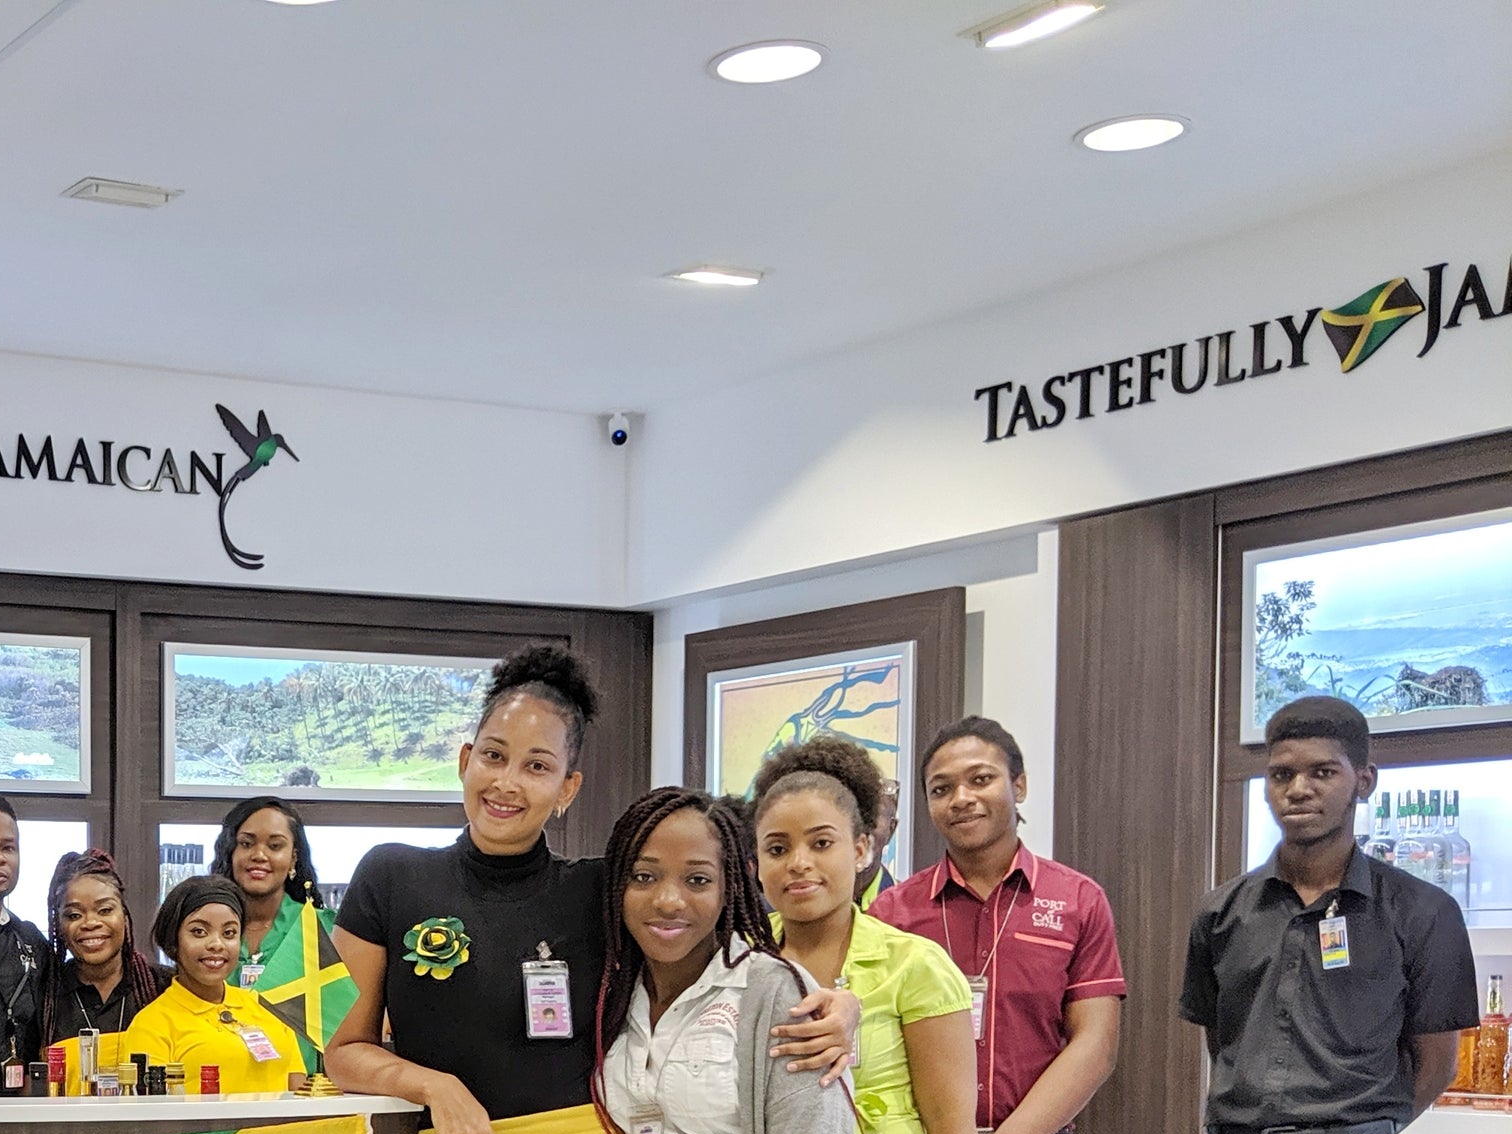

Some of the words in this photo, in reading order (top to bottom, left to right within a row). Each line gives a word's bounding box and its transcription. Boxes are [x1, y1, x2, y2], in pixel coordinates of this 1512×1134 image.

[974, 308, 1323, 444] TASTEFULLY
[1416, 254, 1512, 358] JA
[1032, 896, 1067, 911] PORT
[1031, 912, 1064, 927] CALL
